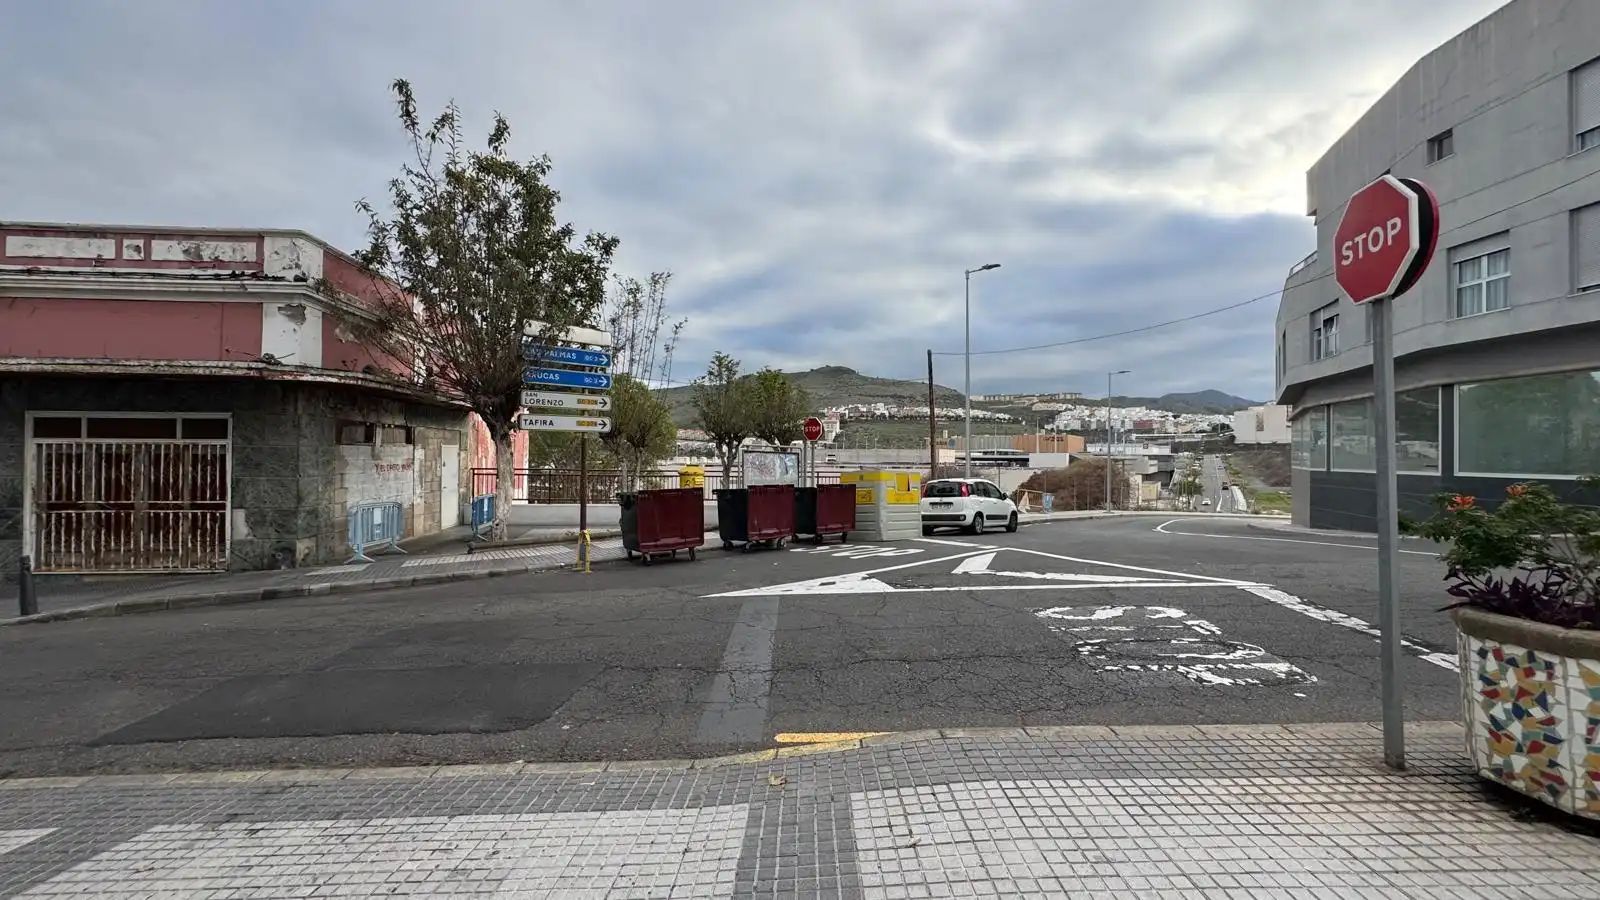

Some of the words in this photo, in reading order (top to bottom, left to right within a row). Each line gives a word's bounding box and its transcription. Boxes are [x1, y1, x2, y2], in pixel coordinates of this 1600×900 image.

[1341, 217, 1402, 266] STOP
[544, 350, 577, 360] PALMAS
[524, 398, 564, 406] LORENZO
[523, 418, 554, 427] TAFIRA
